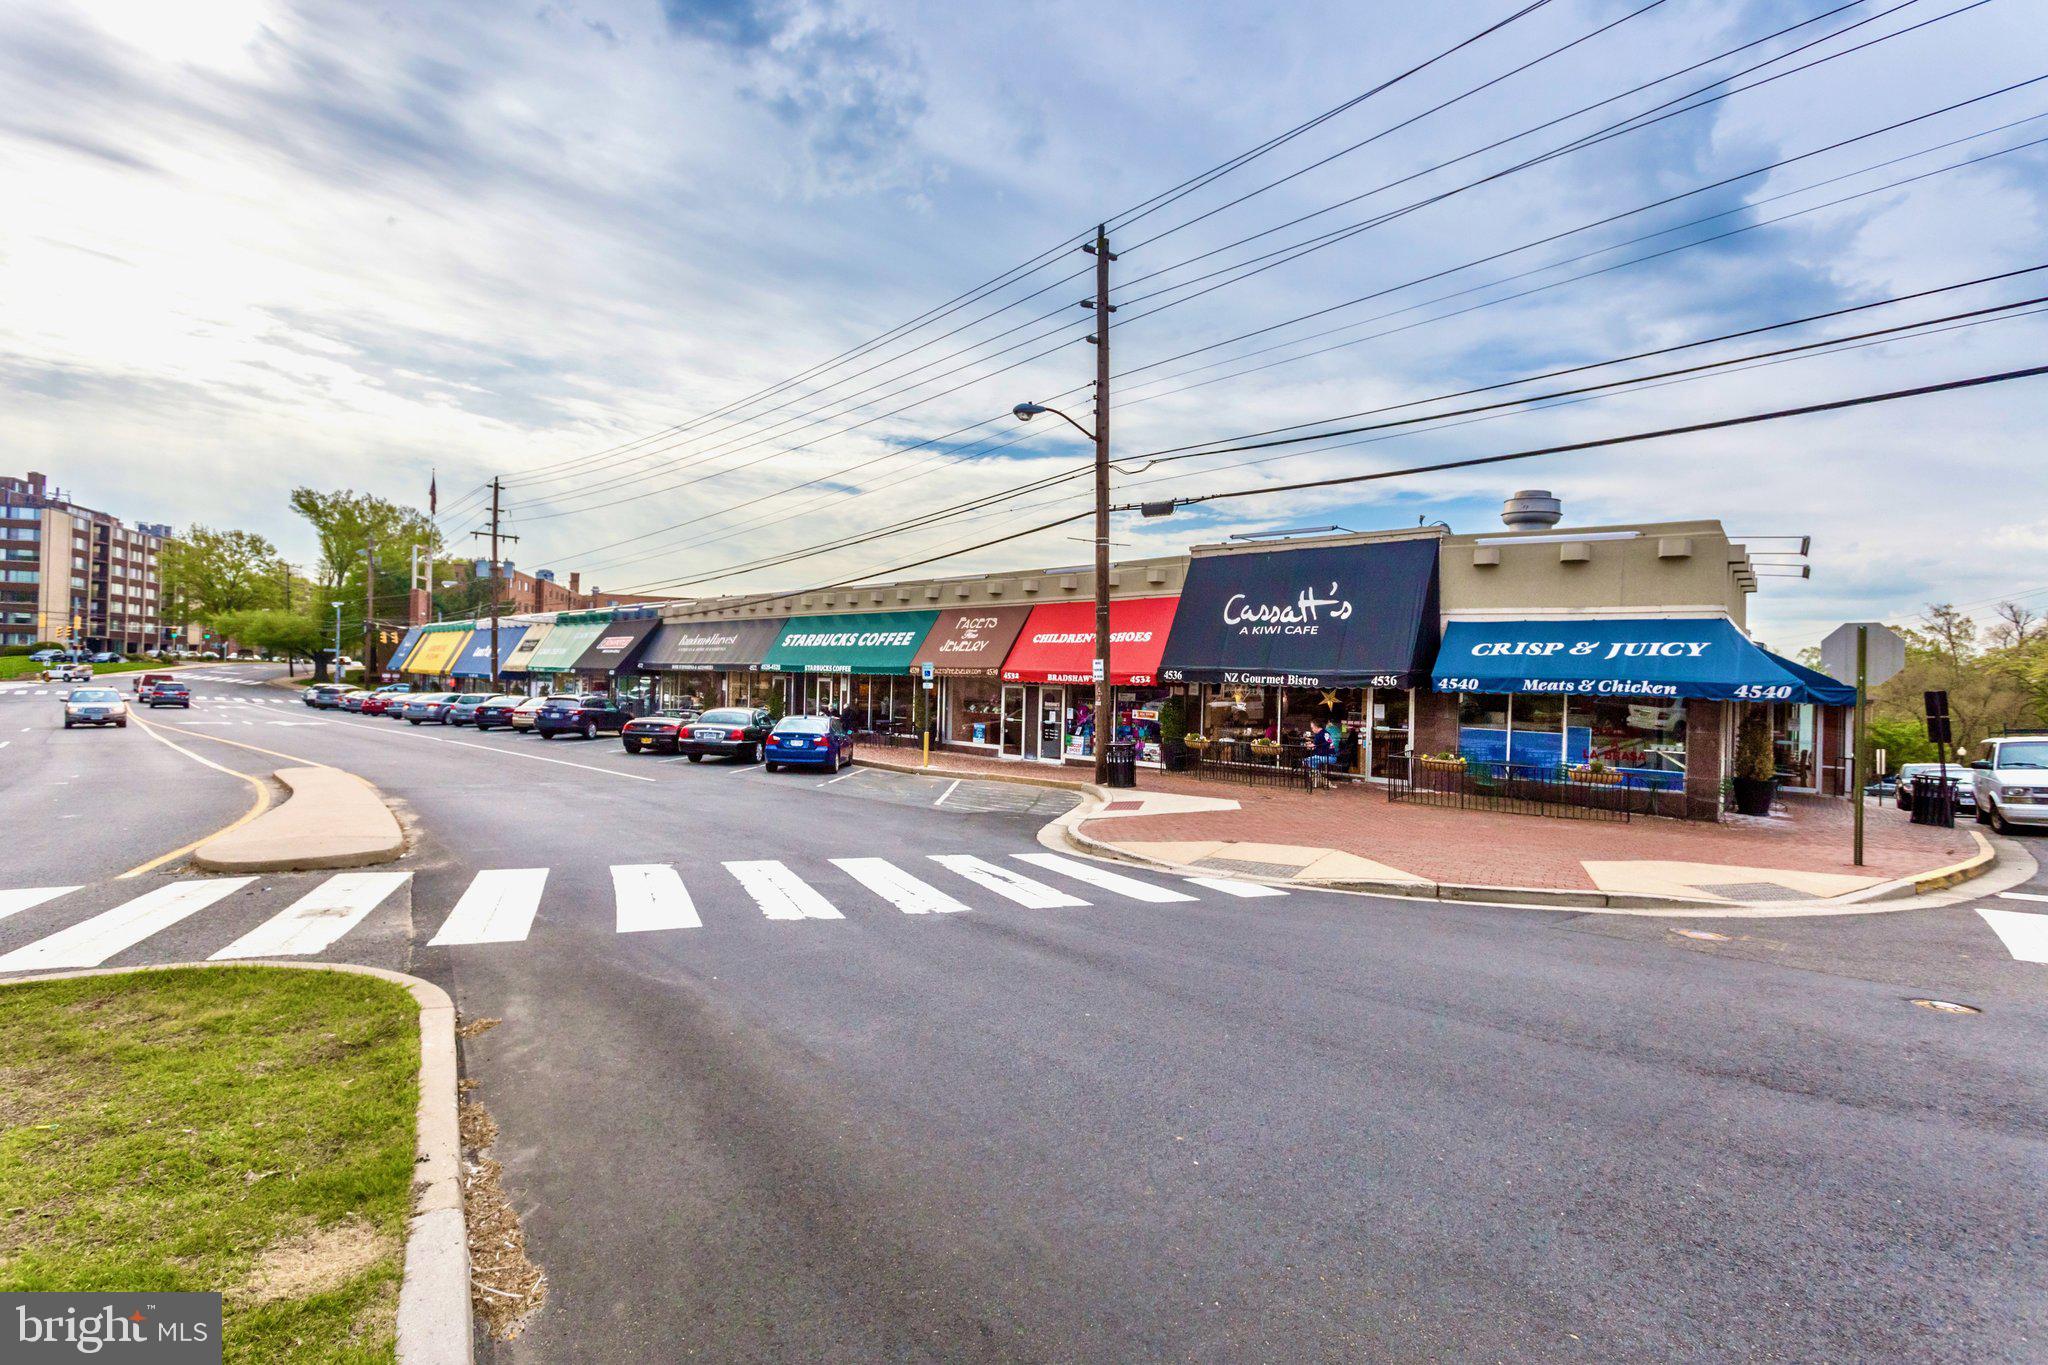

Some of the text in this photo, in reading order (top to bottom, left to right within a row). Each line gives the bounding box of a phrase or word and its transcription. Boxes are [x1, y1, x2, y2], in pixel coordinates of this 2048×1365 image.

[1223, 581, 1353, 625] Cassatt's
[1109, 631, 1153, 643] SHOES
[1238, 626, 1319, 635] A KIWI CAFE
[781, 631, 916, 648] STARBUCKS COFFEE
[1471, 641, 1712, 660] CRISP & JUICY
[804, 664, 851, 673] STARBUCKS COFFEE
[1163, 670, 1183, 680] 4536
[1224, 672, 1319, 686] NZ Gourmet Bistro
[1371, 675, 1397, 686] 4536
[1438, 678, 1479, 690] 4540
[1522, 679, 1677, 695] Meats & Chicken
[1733, 684, 1793, 699] 4540
